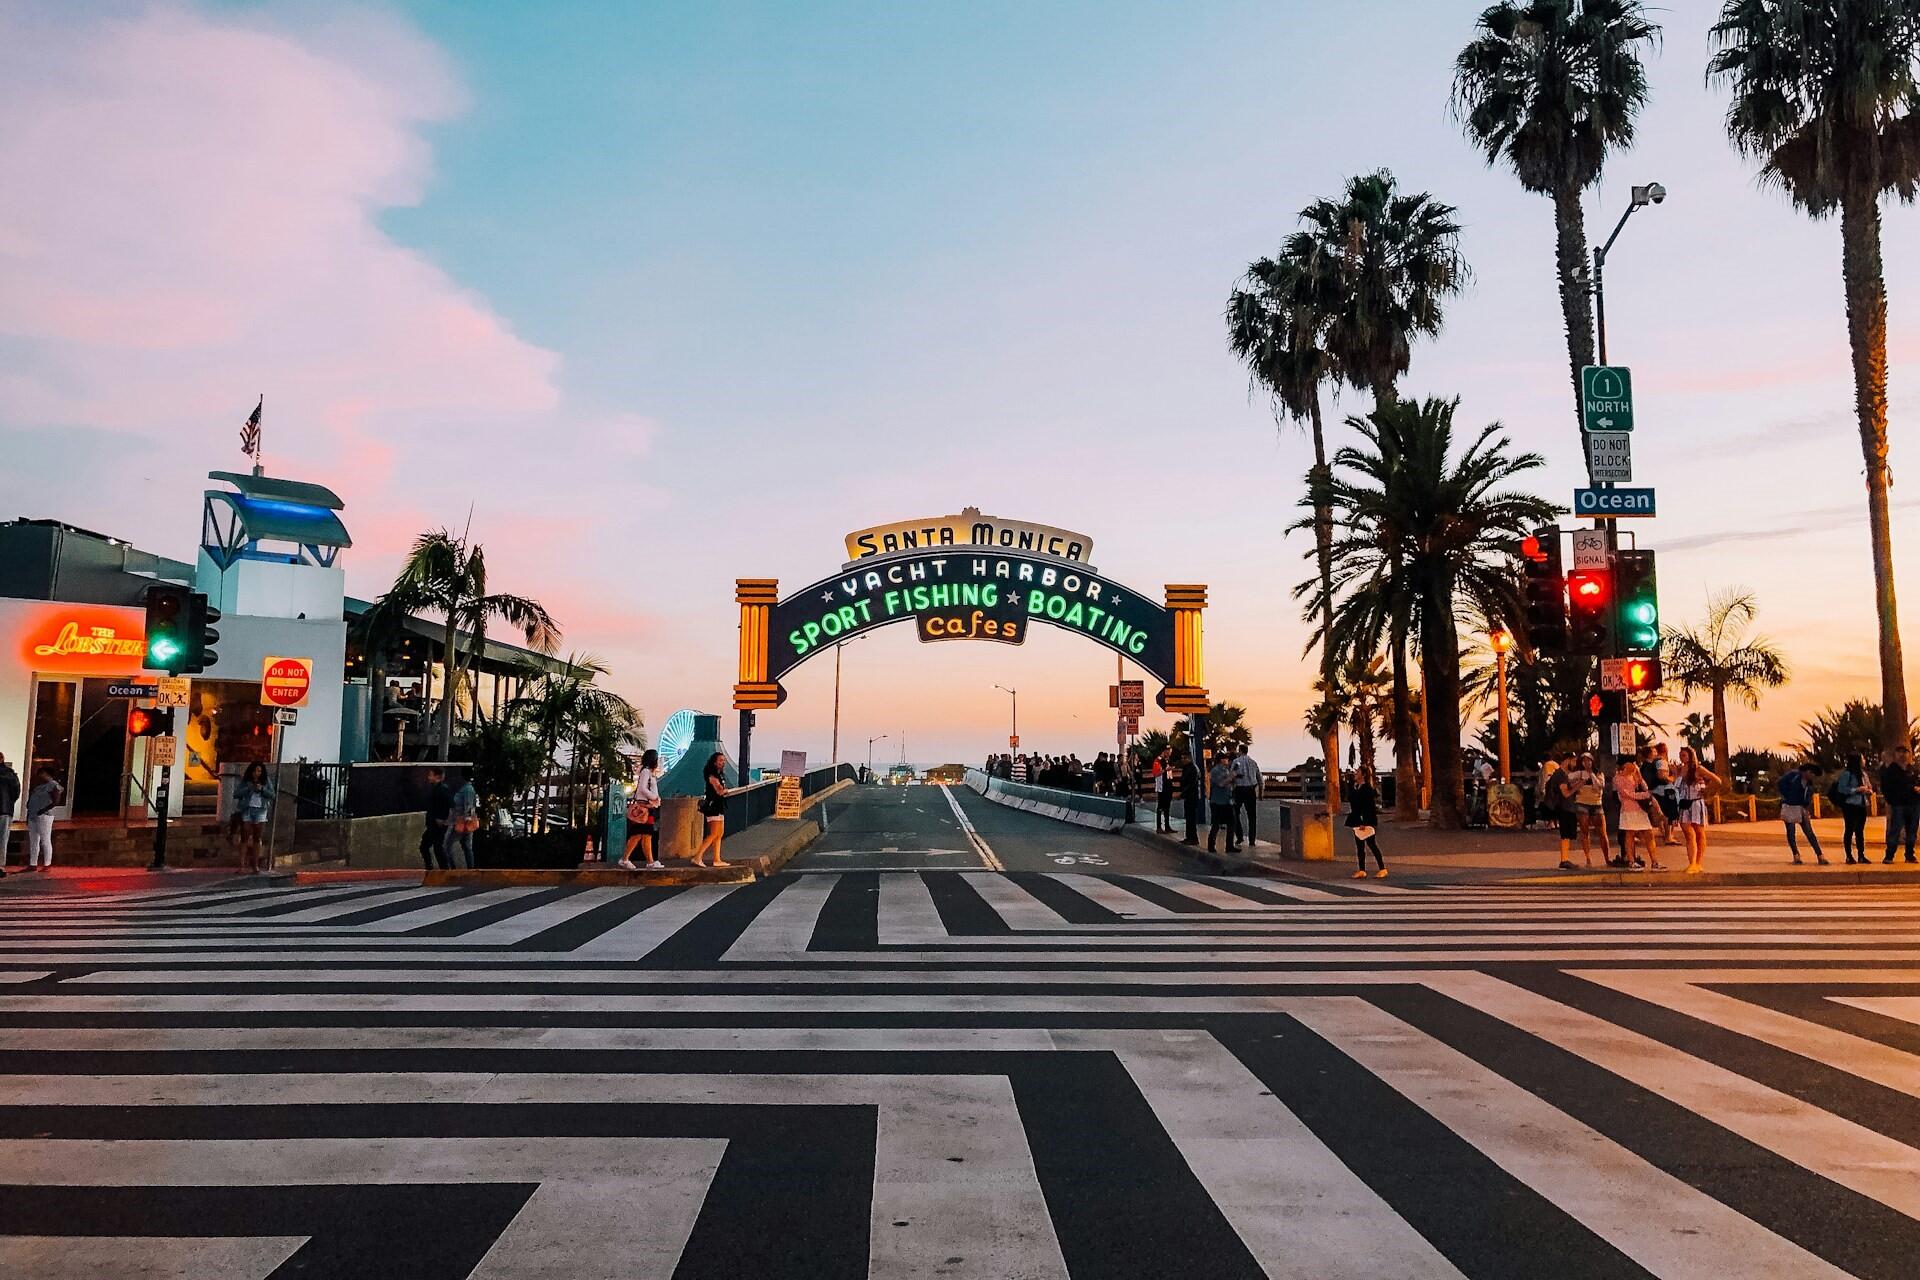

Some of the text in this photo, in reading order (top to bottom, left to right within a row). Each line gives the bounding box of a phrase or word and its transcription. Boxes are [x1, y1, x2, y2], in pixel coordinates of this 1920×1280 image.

[1604, 378, 1610, 393] 1
[1587, 401, 1630, 413] NORTH
[1593, 439, 1628, 451] DO NOT
[1594, 455, 1629, 467] BLOCK
[1594, 469, 1629, 478] INTERSECTION
[1580, 491, 1650, 509] Ocean
[857, 523, 1083, 561] SANTA MONICA
[1576, 555, 1604, 565] SIGNAL
[841, 559, 1103, 601] YACHT HARBOR
[788, 583, 1148, 655] SPORT FISHING BOATING
[90, 626, 115, 638] THE
[271, 667, 305, 677] DO NOT
[1602, 675, 1614, 688] OK
[108, 685, 143, 695] Ocean
[272, 687, 299, 697] ENTER
[159, 692, 170, 704] OK
